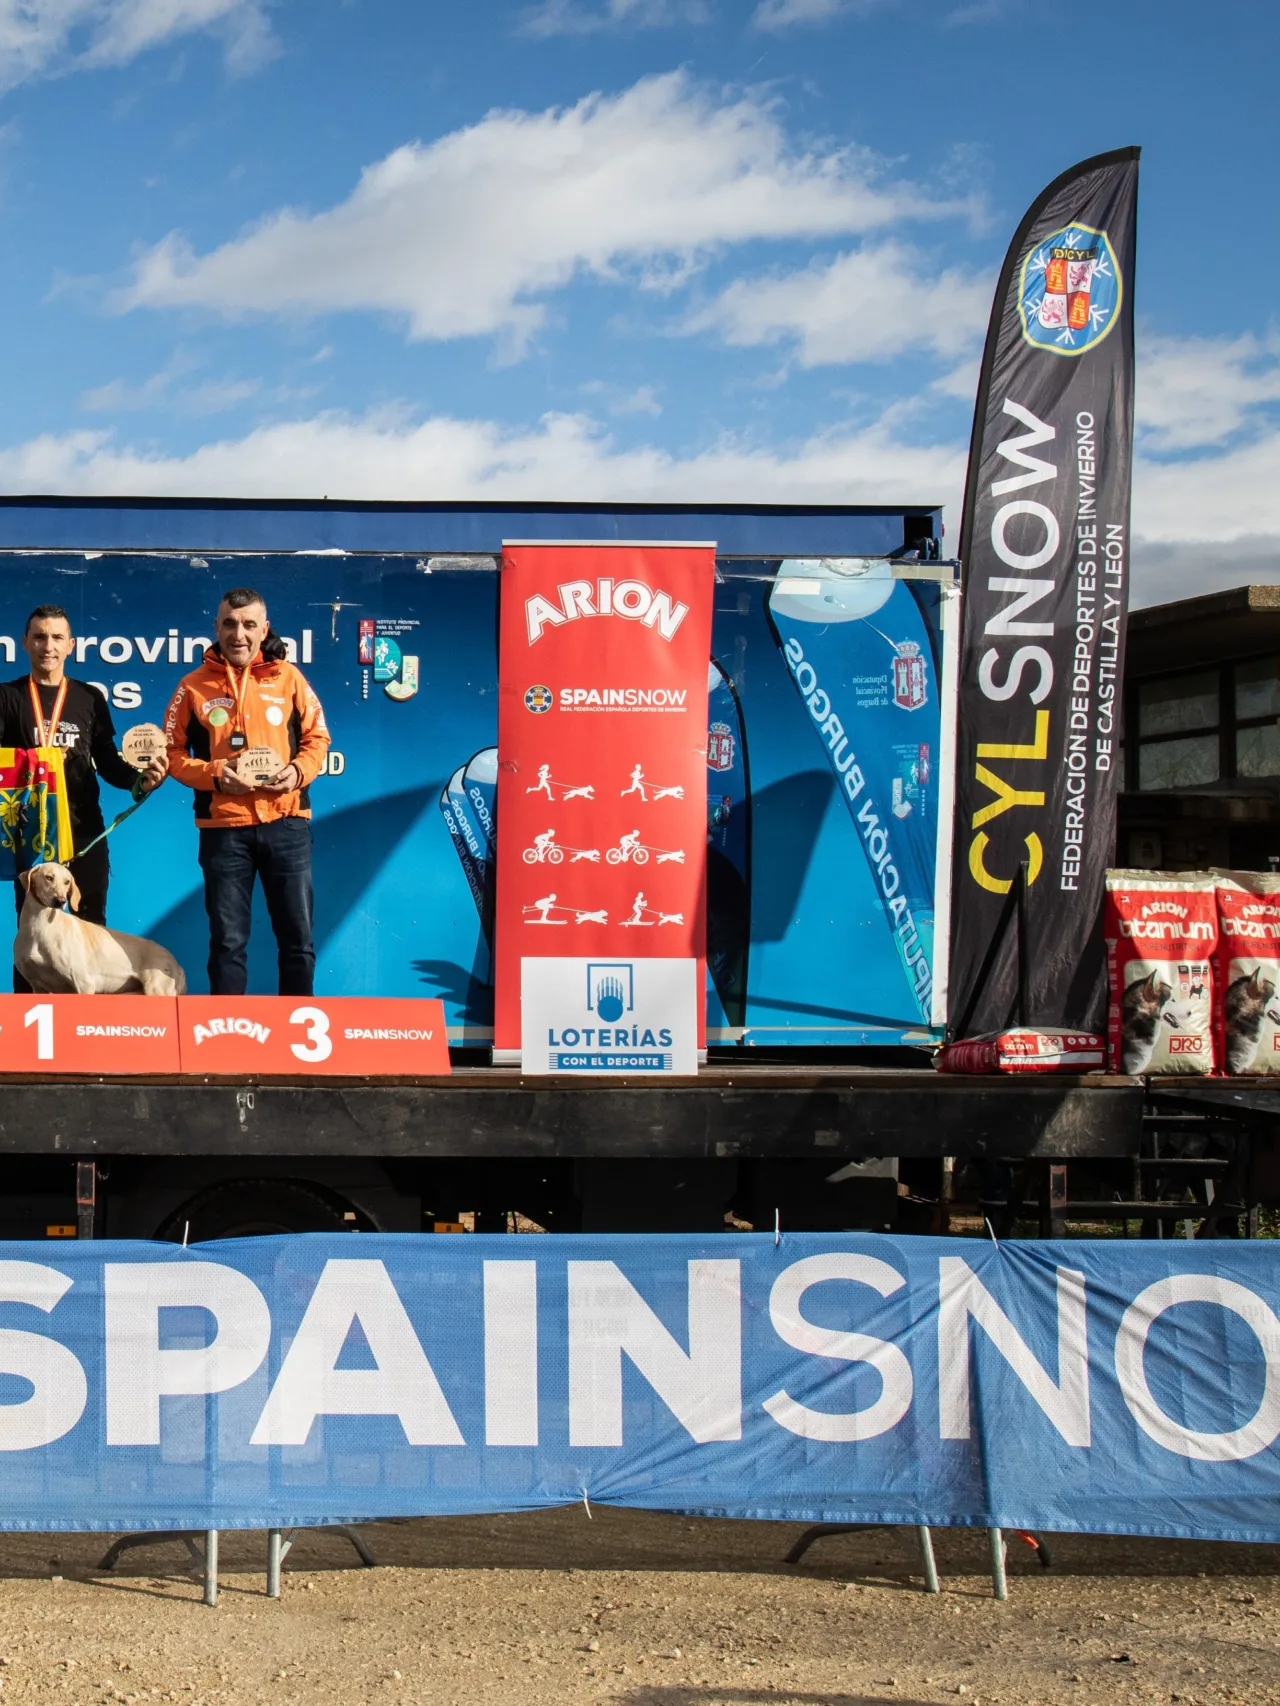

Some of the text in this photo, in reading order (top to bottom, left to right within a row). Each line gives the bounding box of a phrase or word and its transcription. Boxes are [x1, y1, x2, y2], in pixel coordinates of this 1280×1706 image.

[525, 578, 689, 646] ARION
[969, 398, 1060, 894] CYLSNOW
[1061, 411, 1097, 890] FEDERACIÓN DE DEPORTES DE INVIERNO
[1096, 524, 1123, 771] DE CASTILLA Y LEÓN
[202, 698, 235, 714] ARION
[560, 688, 687, 705] SPAINSNOW
[1142, 902, 1188, 919] ARION
[24, 1004, 54, 1059] 1
[76, 1025, 167, 1038] SPAINSNOW
[193, 1006, 433, 1063] ARION 3 SPAINSNOW
[548, 1024, 673, 1047] LOTERÍAS
[562, 1057, 659, 1066] CON EL DEPORTE
